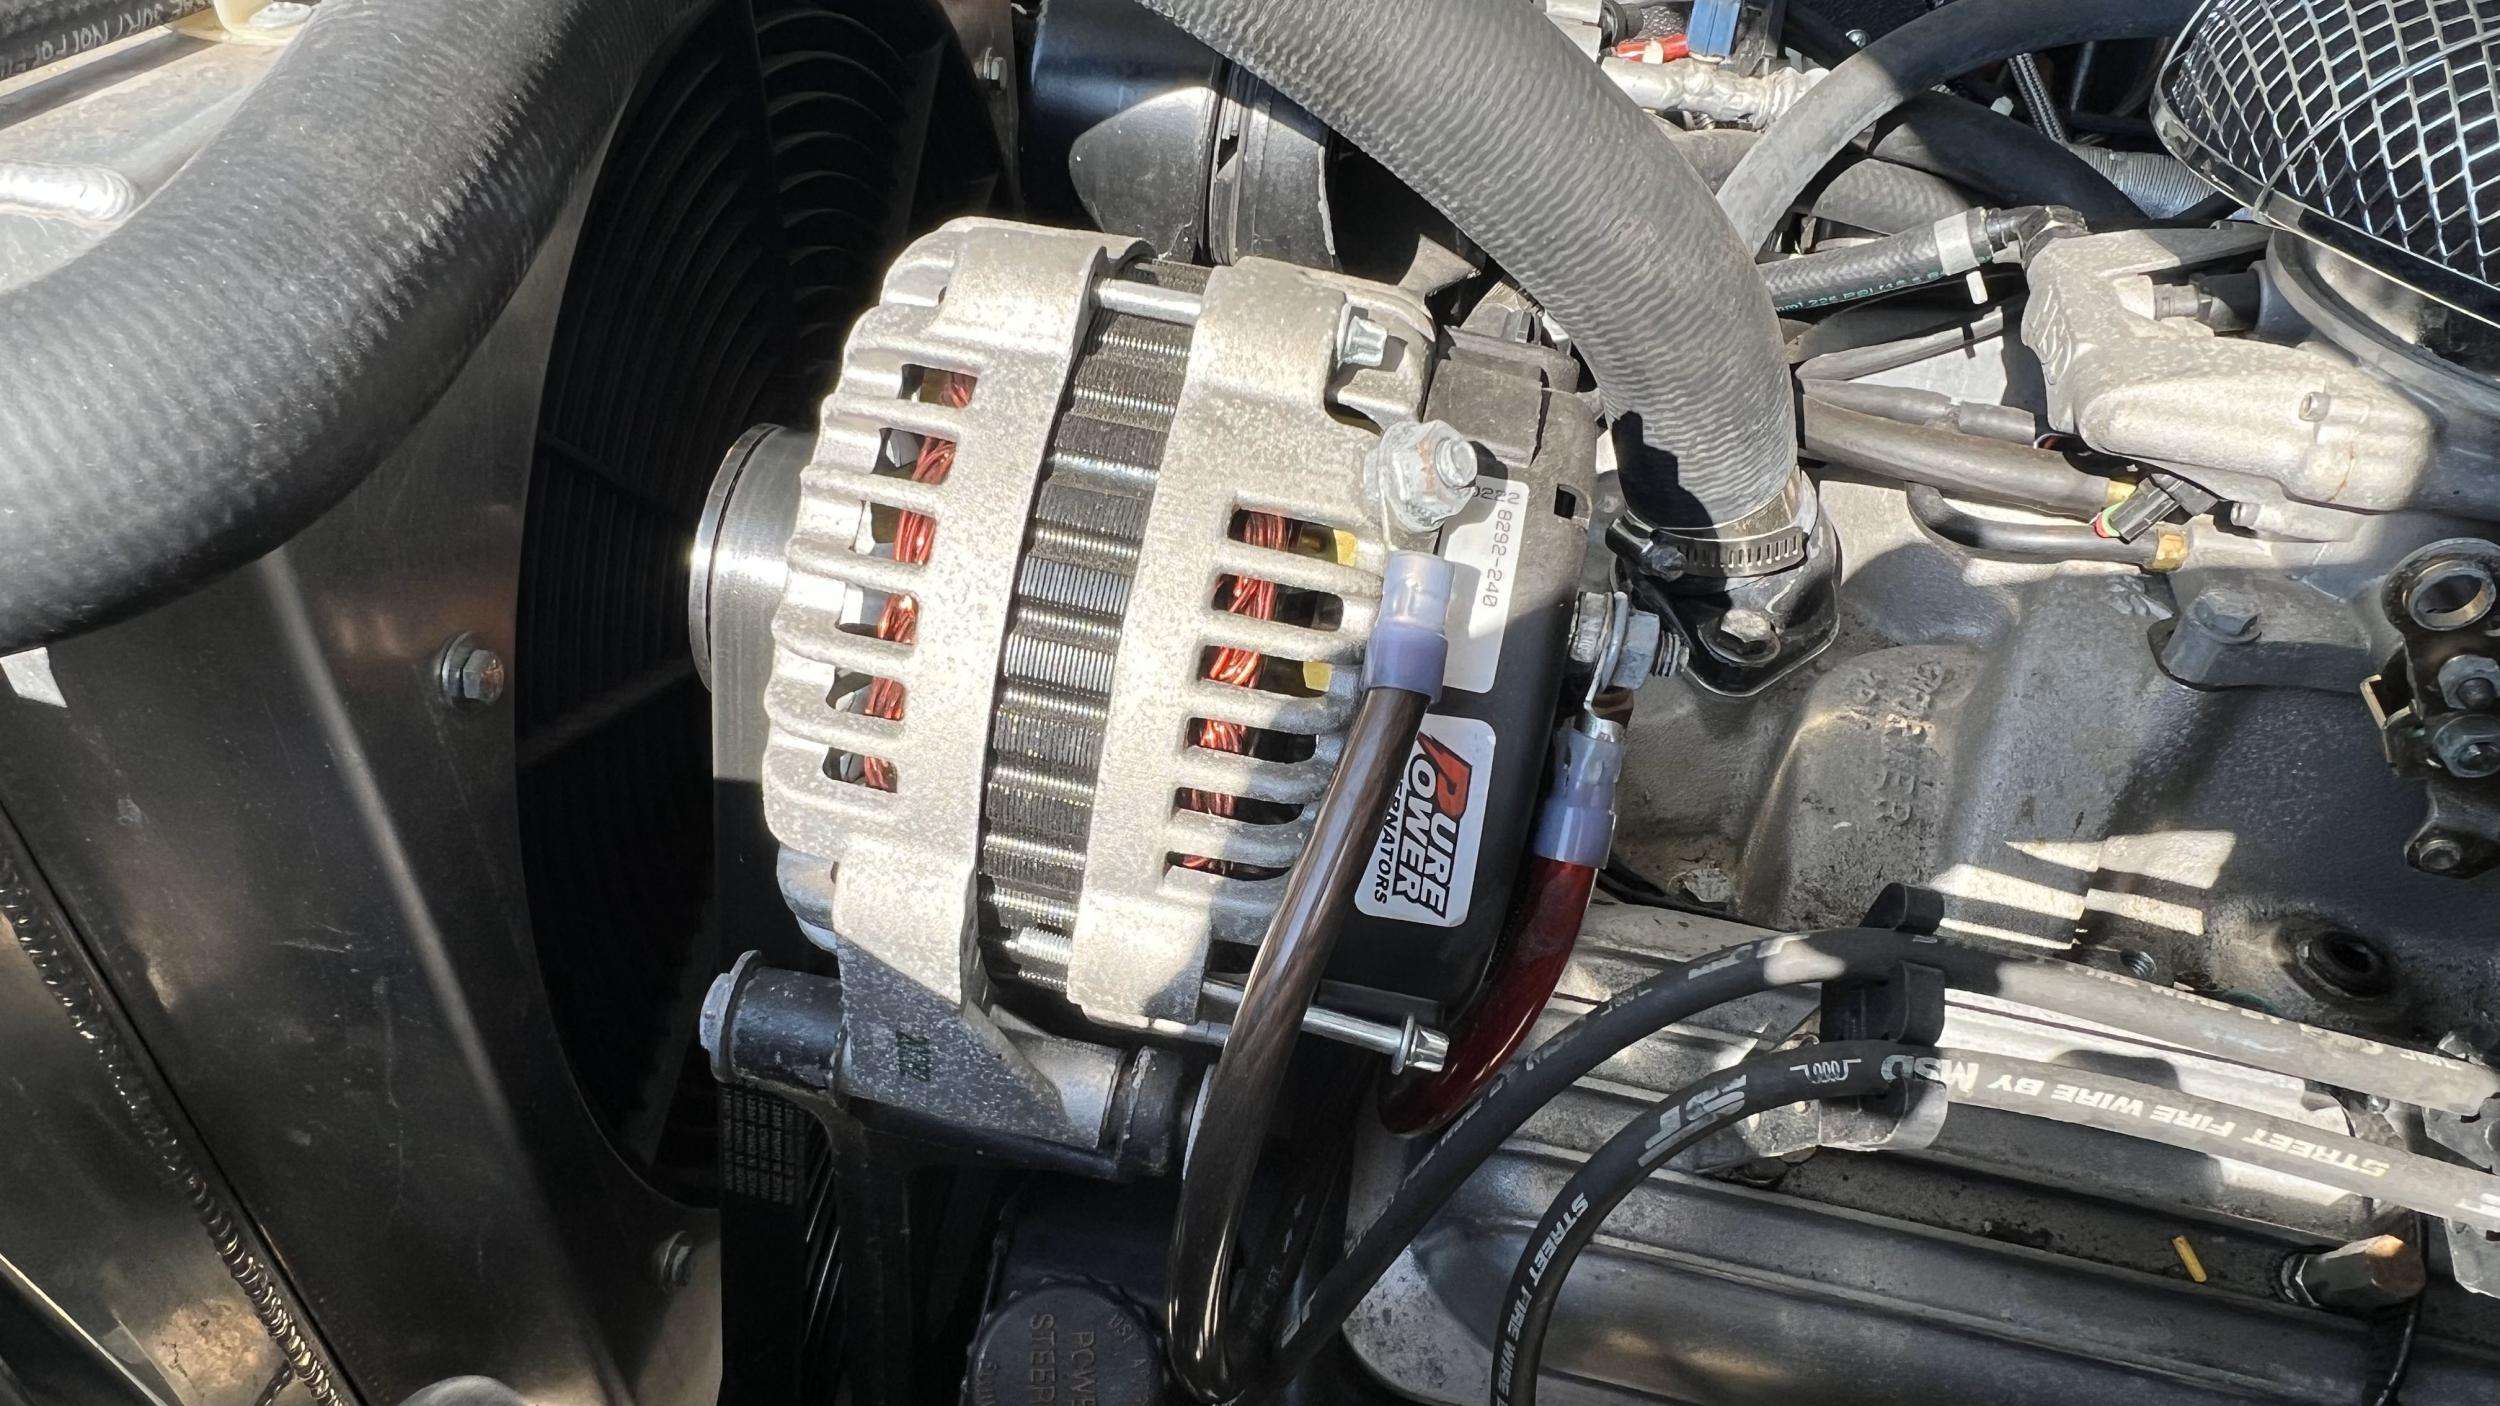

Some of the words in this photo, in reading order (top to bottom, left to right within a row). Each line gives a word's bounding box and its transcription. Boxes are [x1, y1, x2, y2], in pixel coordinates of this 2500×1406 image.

[1483, 510, 1513, 608] 8292-240
[1881, 1054, 1980, 1094] MSD
[1987, 1073, 2045, 1097] BY
[2051, 1083, 2145, 1119] WIRE
[2150, 1104, 2237, 1139] FIRE
[2242, 1128, 2391, 1178] STREET
[1528, 1192, 1589, 1287] STREET
[1508, 1285, 1533, 1341] FIRE
[1498, 1340, 1516, 1395] WIRE
